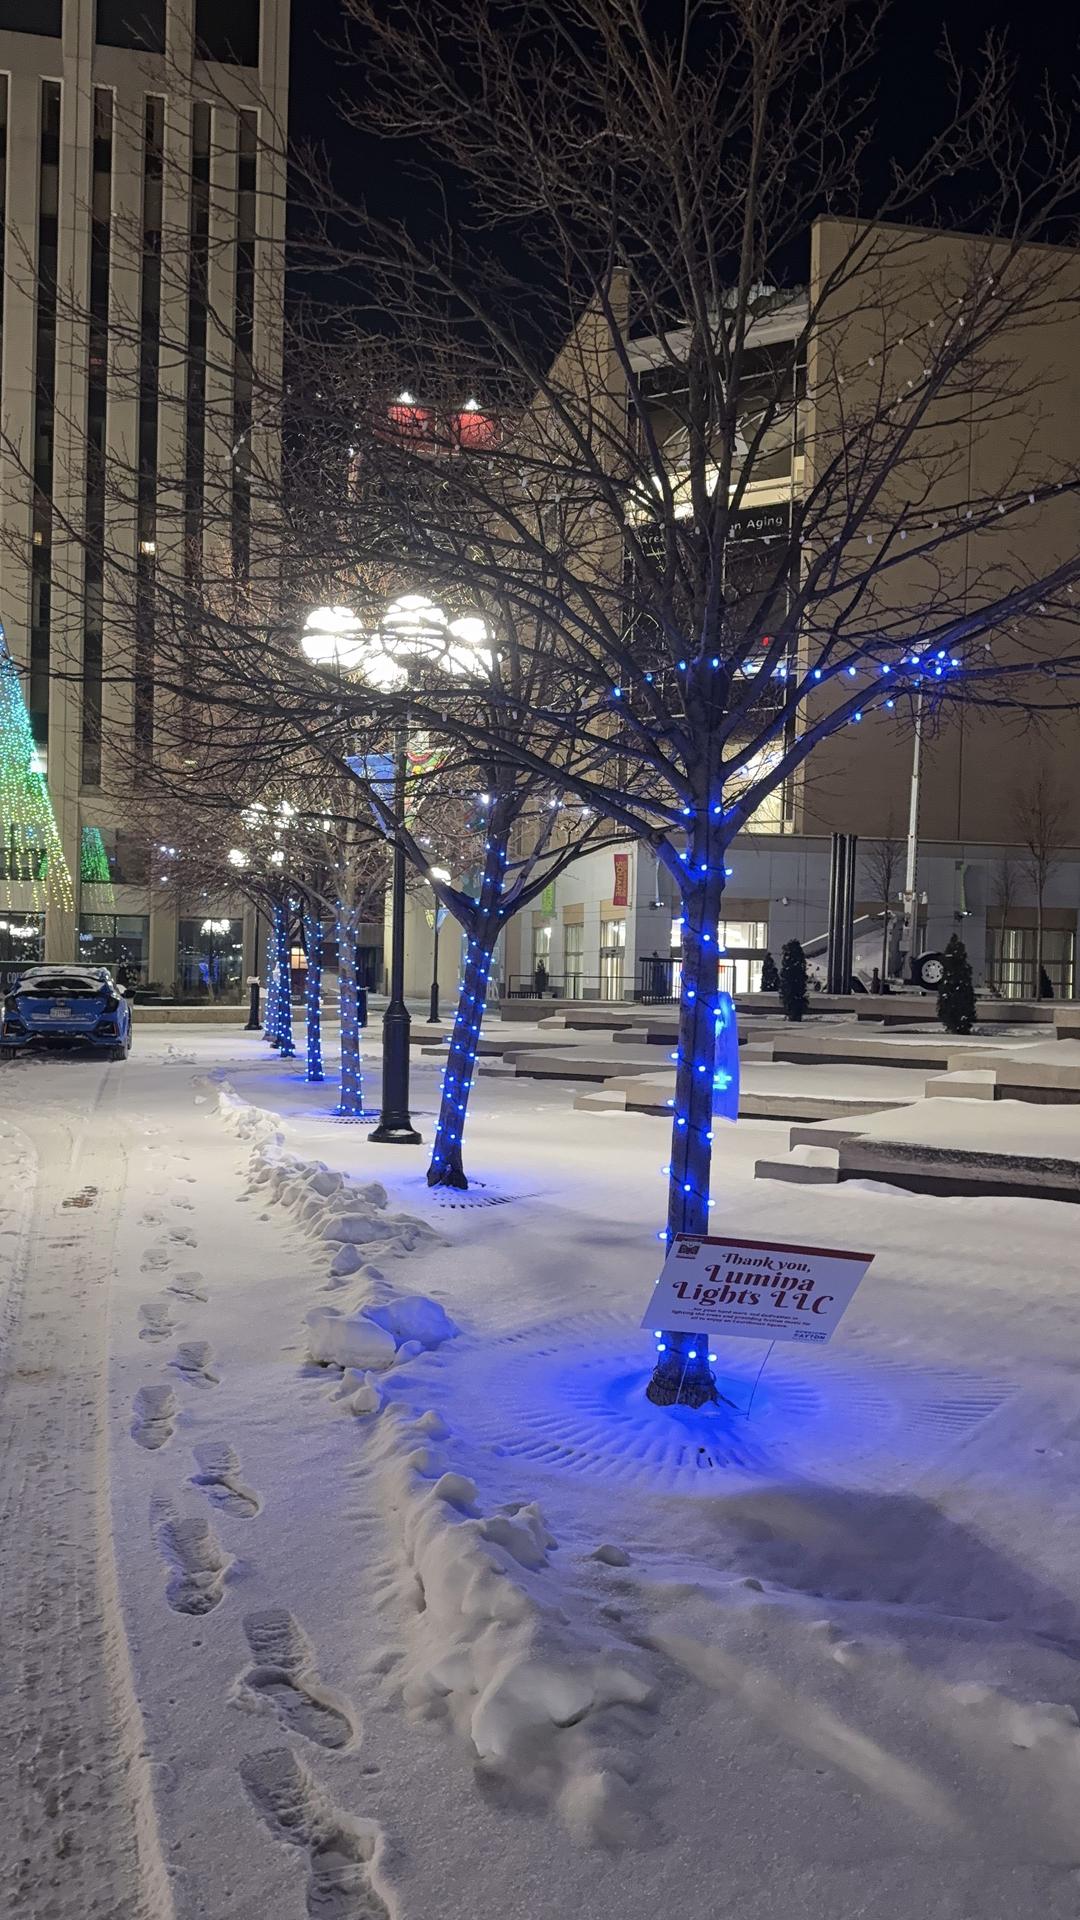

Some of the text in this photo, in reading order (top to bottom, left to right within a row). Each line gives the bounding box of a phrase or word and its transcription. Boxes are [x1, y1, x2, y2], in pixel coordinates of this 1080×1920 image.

[746, 515, 783, 530] Aging
[615, 861, 624, 897] SQUARE
[722, 1252, 811, 1273] Thank you,
[704, 1264, 816, 1292] Lumina
[672, 1281, 834, 1315] Lights LLC
